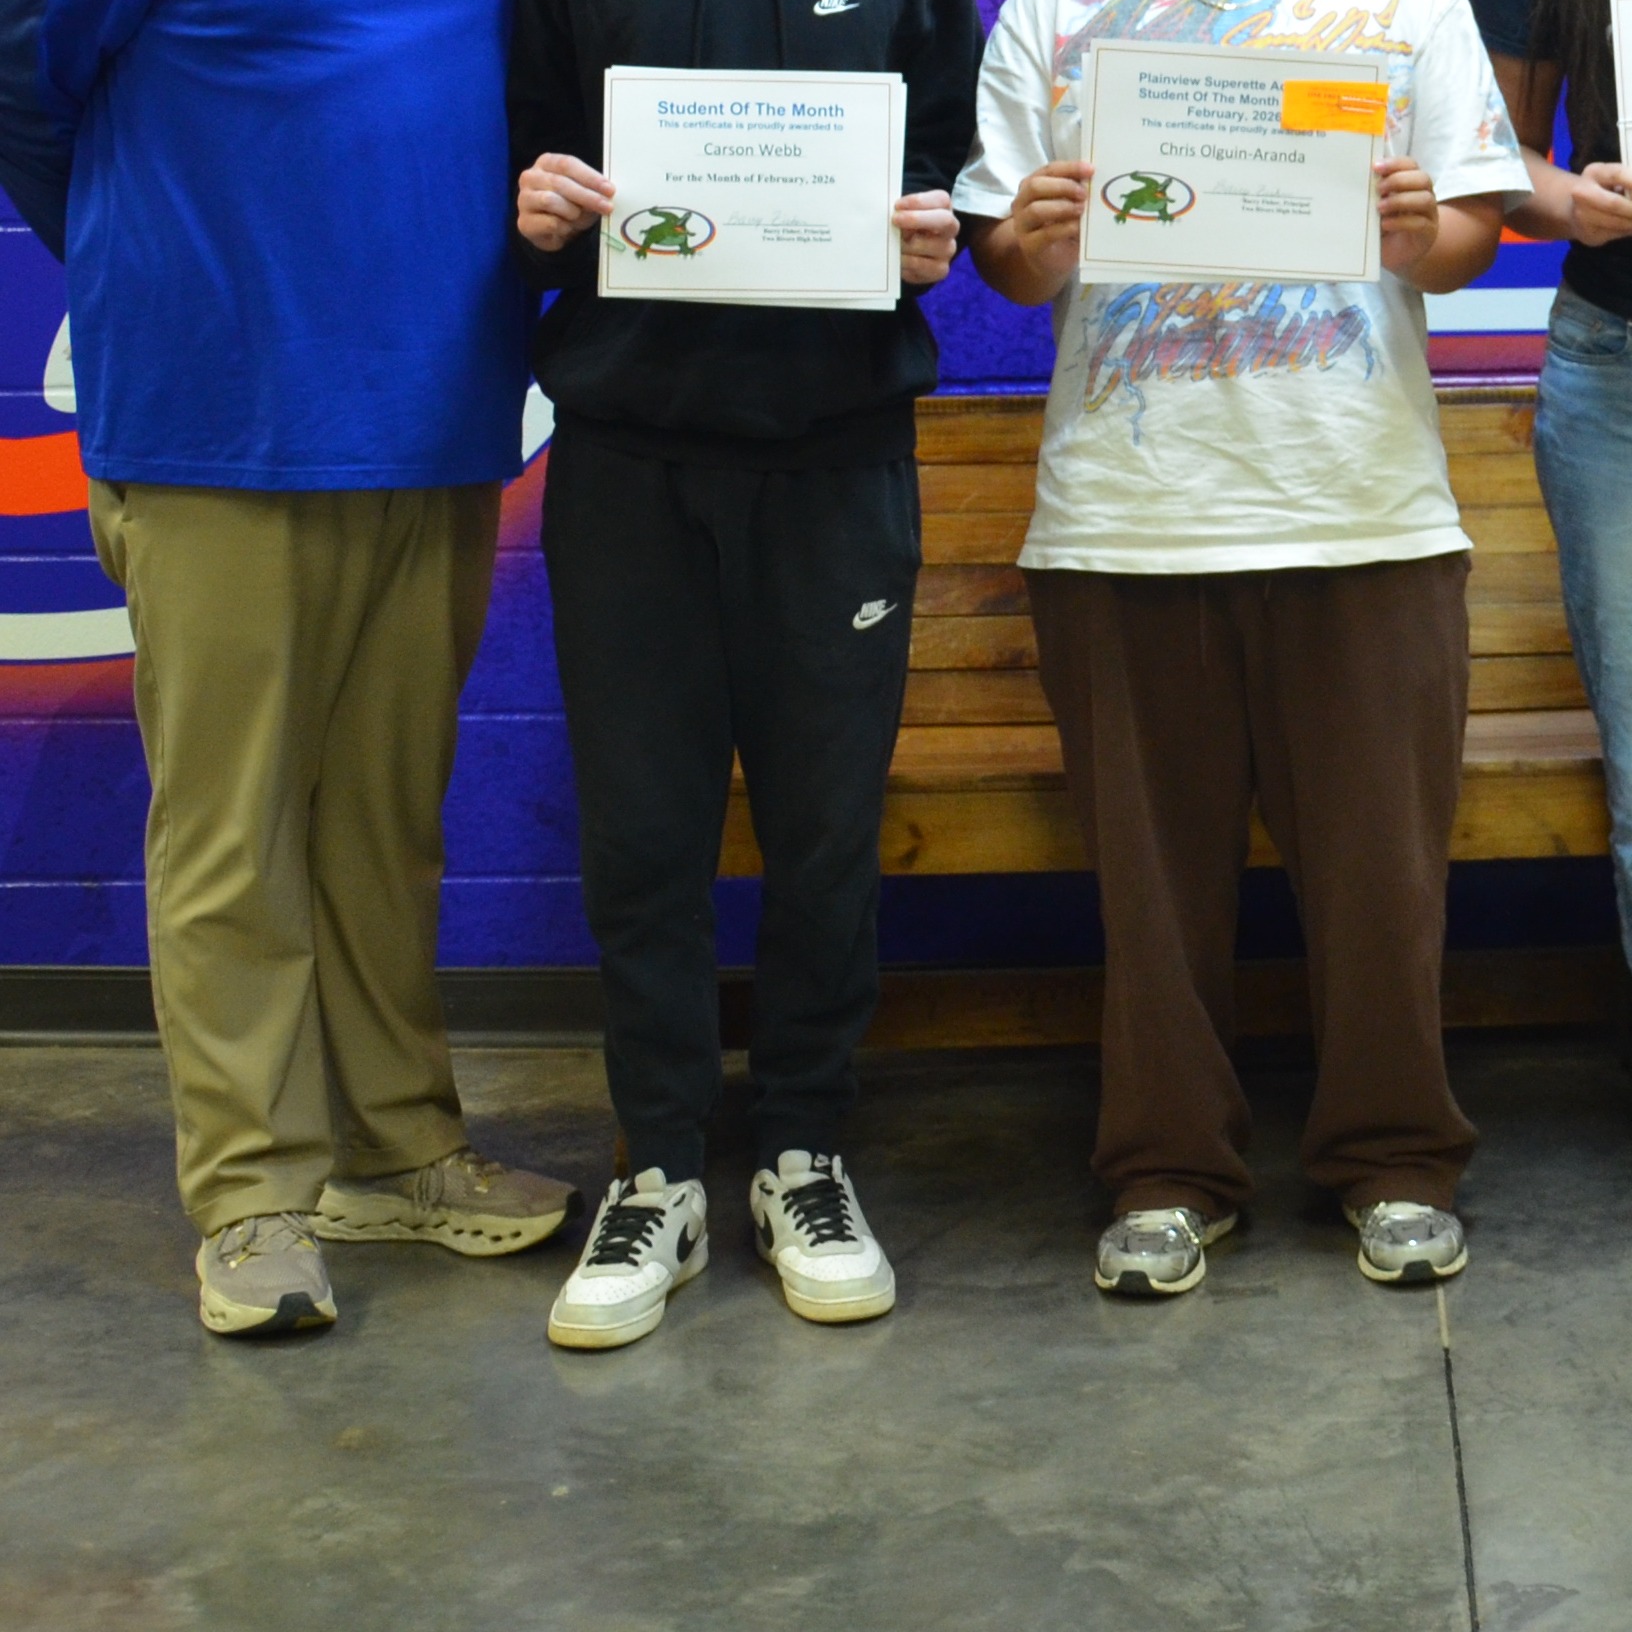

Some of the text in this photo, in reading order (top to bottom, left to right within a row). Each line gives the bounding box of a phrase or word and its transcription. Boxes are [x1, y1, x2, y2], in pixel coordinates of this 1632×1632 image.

[1139, 72, 1201, 86] Plainview
[1204, 76, 1266, 91] Superette
[1139, 87, 1279, 107] Student Of The Month
[658, 101, 844, 117] Student Of The Month
[1252, 110, 1282, 124] 2026
[658, 119, 680, 129] This
[682, 120, 733, 129] certificate
[747, 121, 786, 132] proudly
[788, 122, 831, 131] awarded
[1141, 117, 1162, 128] This
[1165, 121, 1215, 131] certificate
[1229, 125, 1268, 136] proudly
[704, 142, 802, 158] Carson Webb
[1159, 142, 1305, 164] Chris Olguin-Aranda
[665, 172, 684, 182] For
[687, 173, 703, 182] the
[707, 173, 741, 183] Month
[812, 174, 836, 184] 2026
